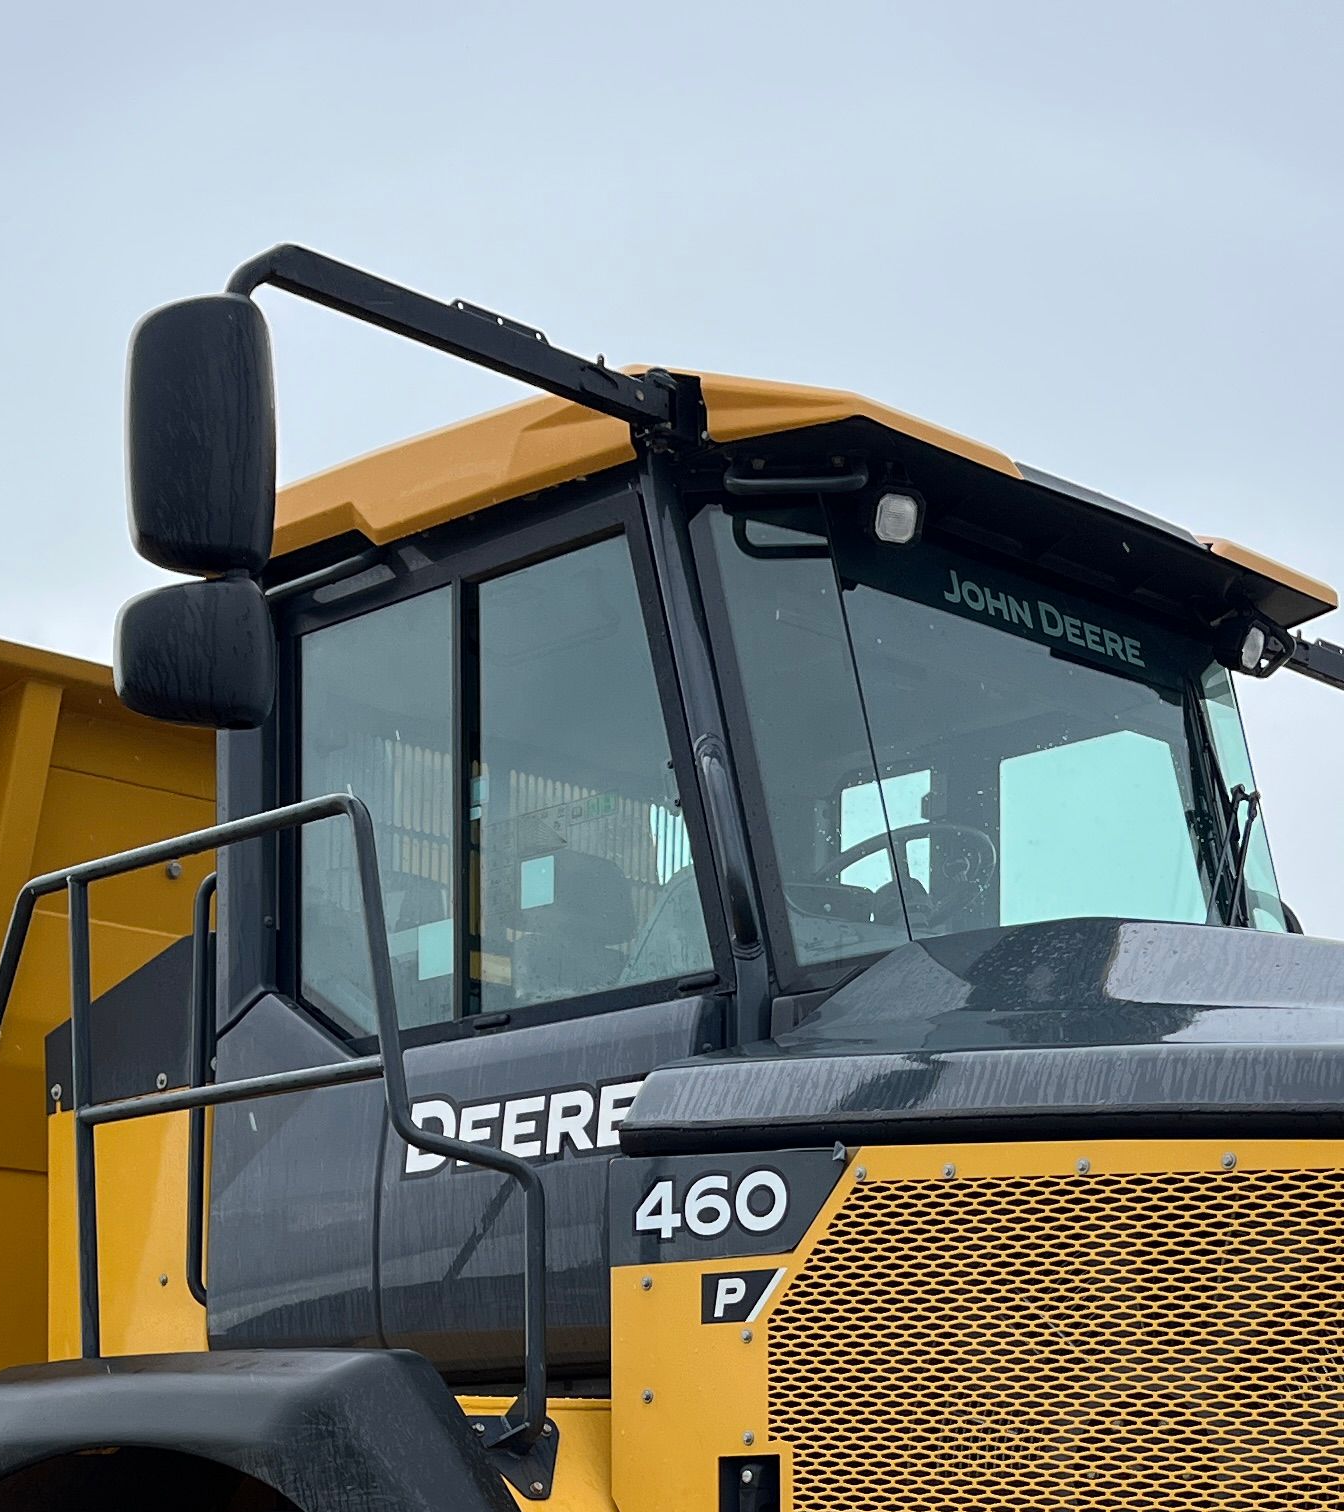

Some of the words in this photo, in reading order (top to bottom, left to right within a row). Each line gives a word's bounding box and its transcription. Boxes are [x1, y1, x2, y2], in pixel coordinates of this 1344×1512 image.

[943, 569, 1033, 629] JOHN
[1037, 600, 1146, 668] DEERE
[635, 1170, 788, 1239] 460
[714, 1278, 746, 1318] P
